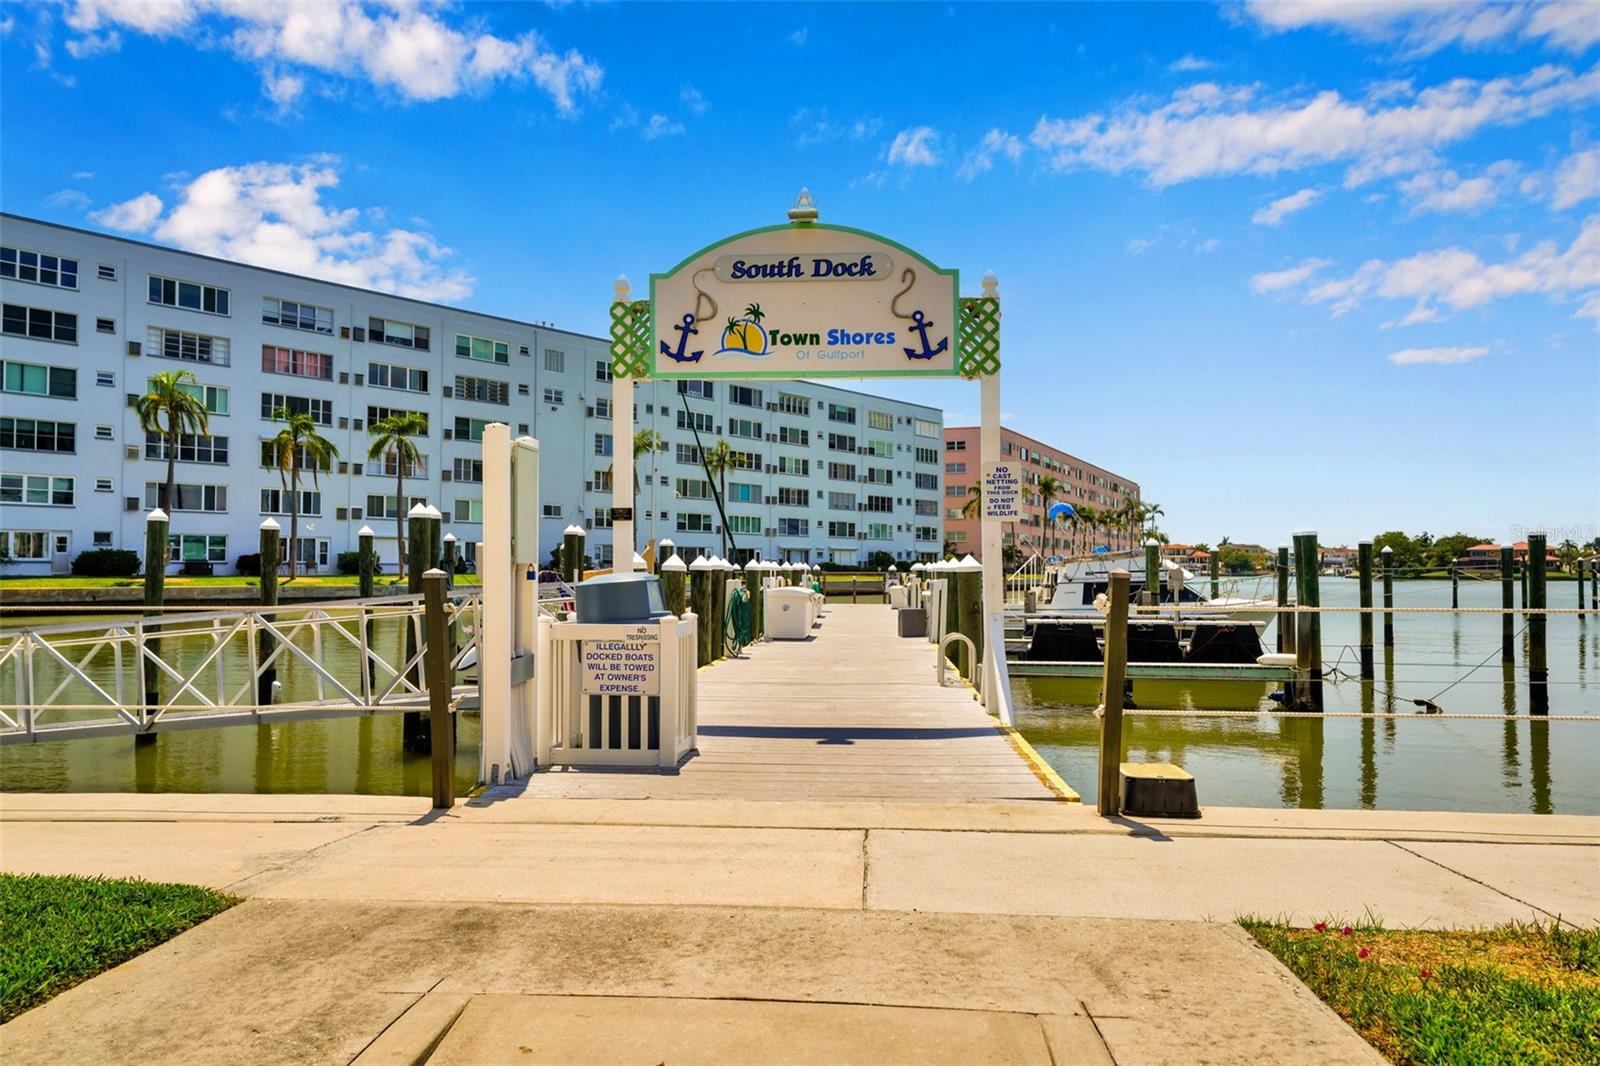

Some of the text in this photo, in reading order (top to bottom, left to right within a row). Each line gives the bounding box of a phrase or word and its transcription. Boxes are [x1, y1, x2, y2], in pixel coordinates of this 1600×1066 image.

[730, 255, 876, 280] South Dock
[769, 328, 896, 346] Town Shores
[796, 350, 865, 360] Of Gulfport
[586, 652, 654, 661] DOCKED BOATS
[587, 663, 655, 671] WILL BE TOWED
[594, 673, 647, 682] AT OWNER'S
